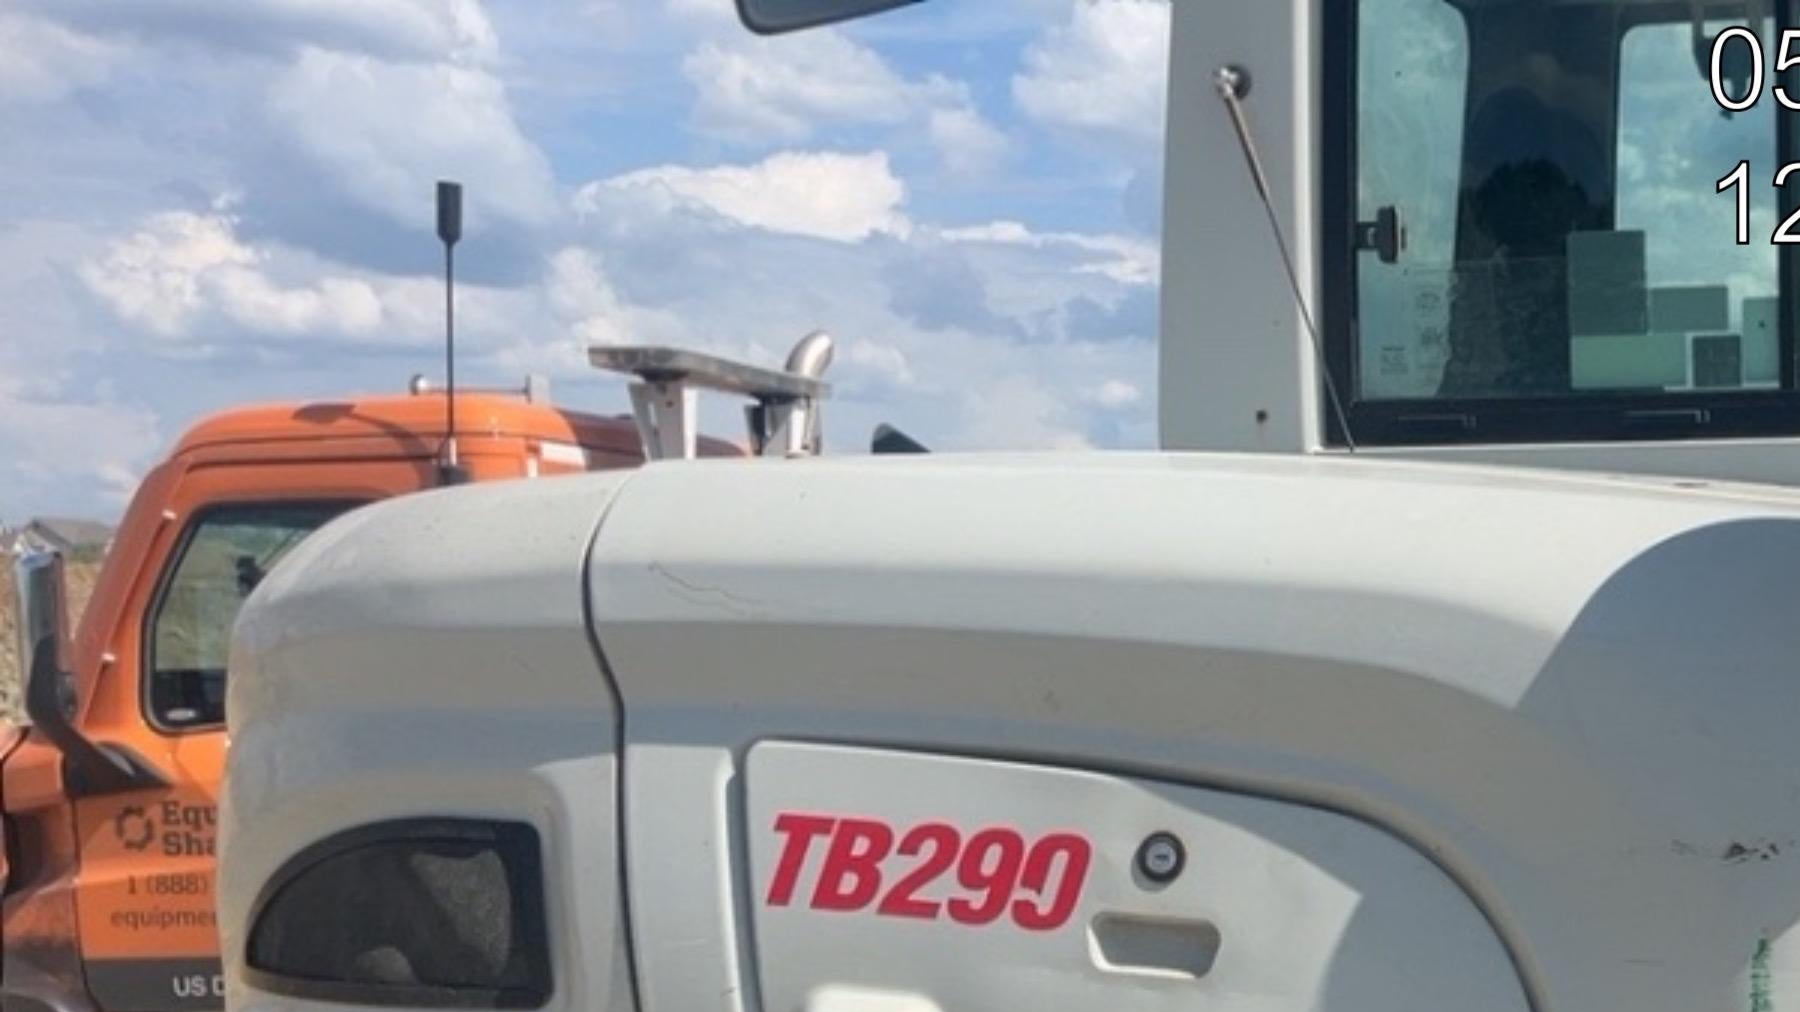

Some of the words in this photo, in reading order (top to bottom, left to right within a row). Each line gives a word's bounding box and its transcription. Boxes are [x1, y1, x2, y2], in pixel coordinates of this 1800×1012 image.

[766, 813, 1092, 932] TB290
[146, 873, 208, 896] (888)
[173, 974, 209, 997] US
